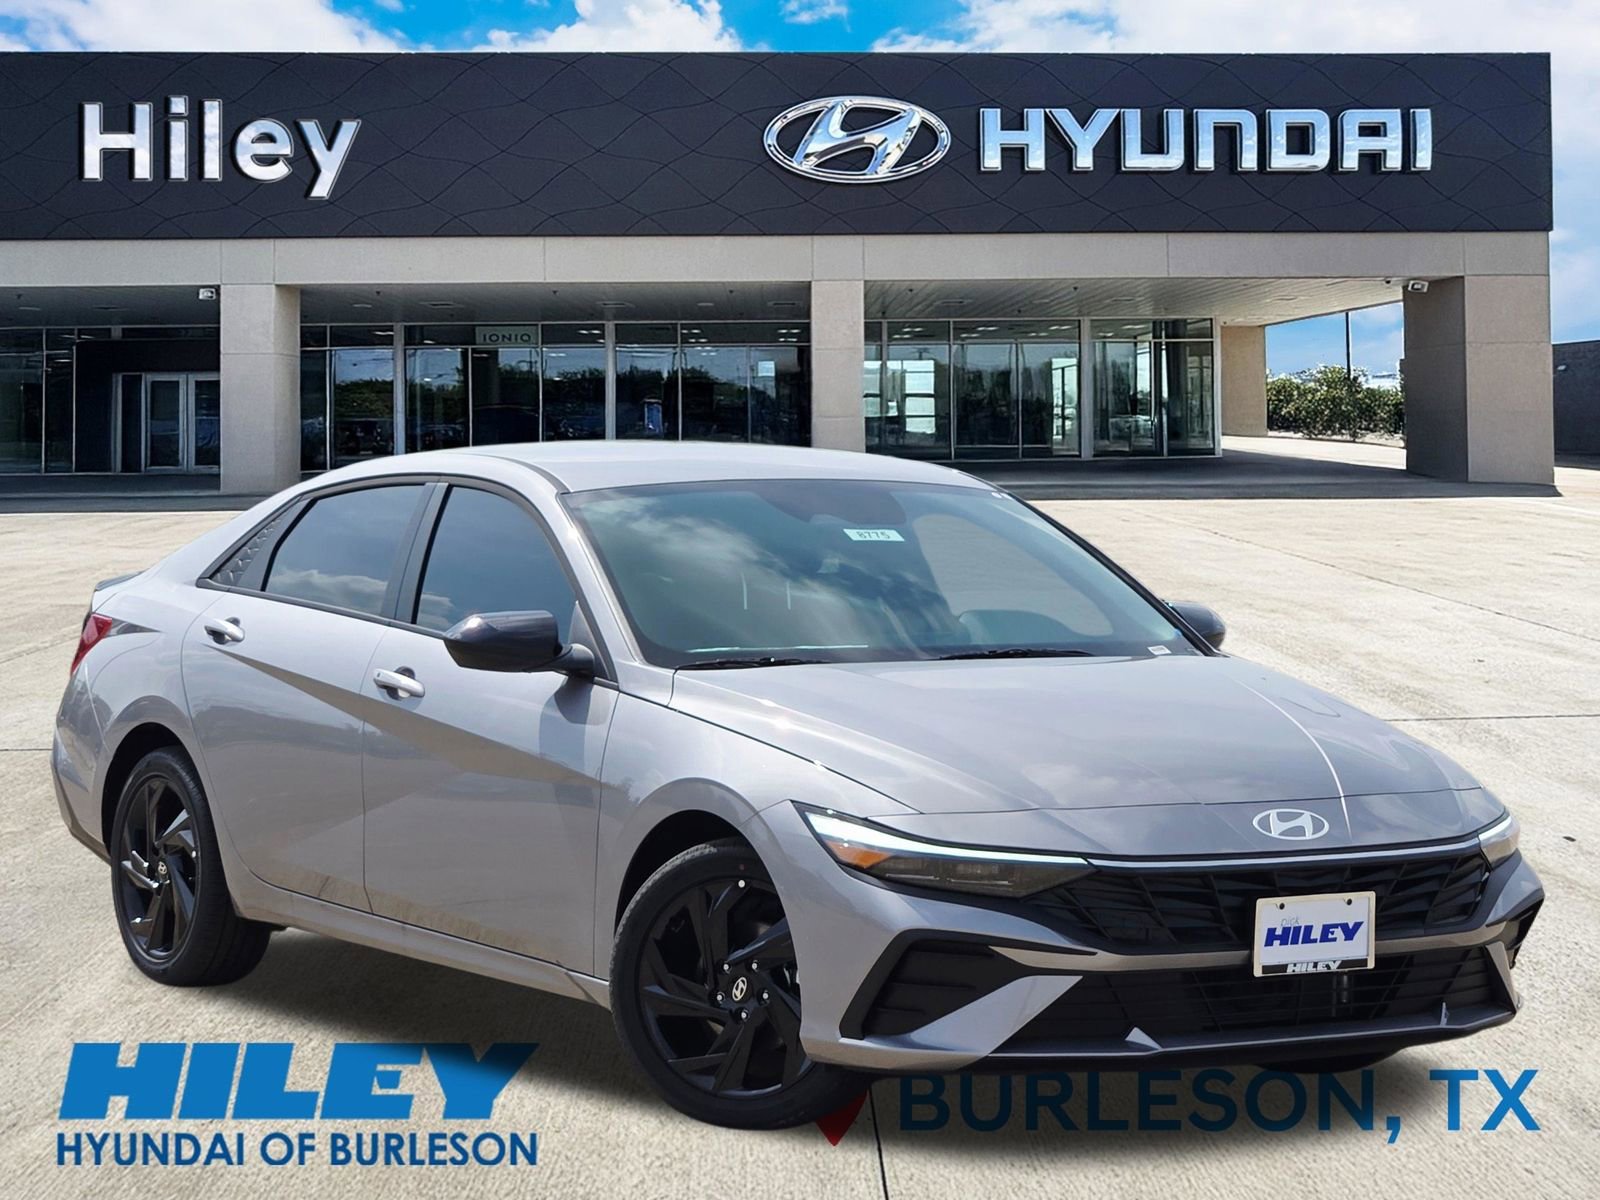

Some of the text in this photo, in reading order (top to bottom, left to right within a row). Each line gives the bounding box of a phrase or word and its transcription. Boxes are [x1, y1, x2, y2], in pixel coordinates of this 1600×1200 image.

[80, 95, 361, 200] Hiley
[979, 107, 1432, 173] HYUNDAI
[1264, 921, 1364, 948] HILEY
[1286, 960, 1342, 973] HILEY
